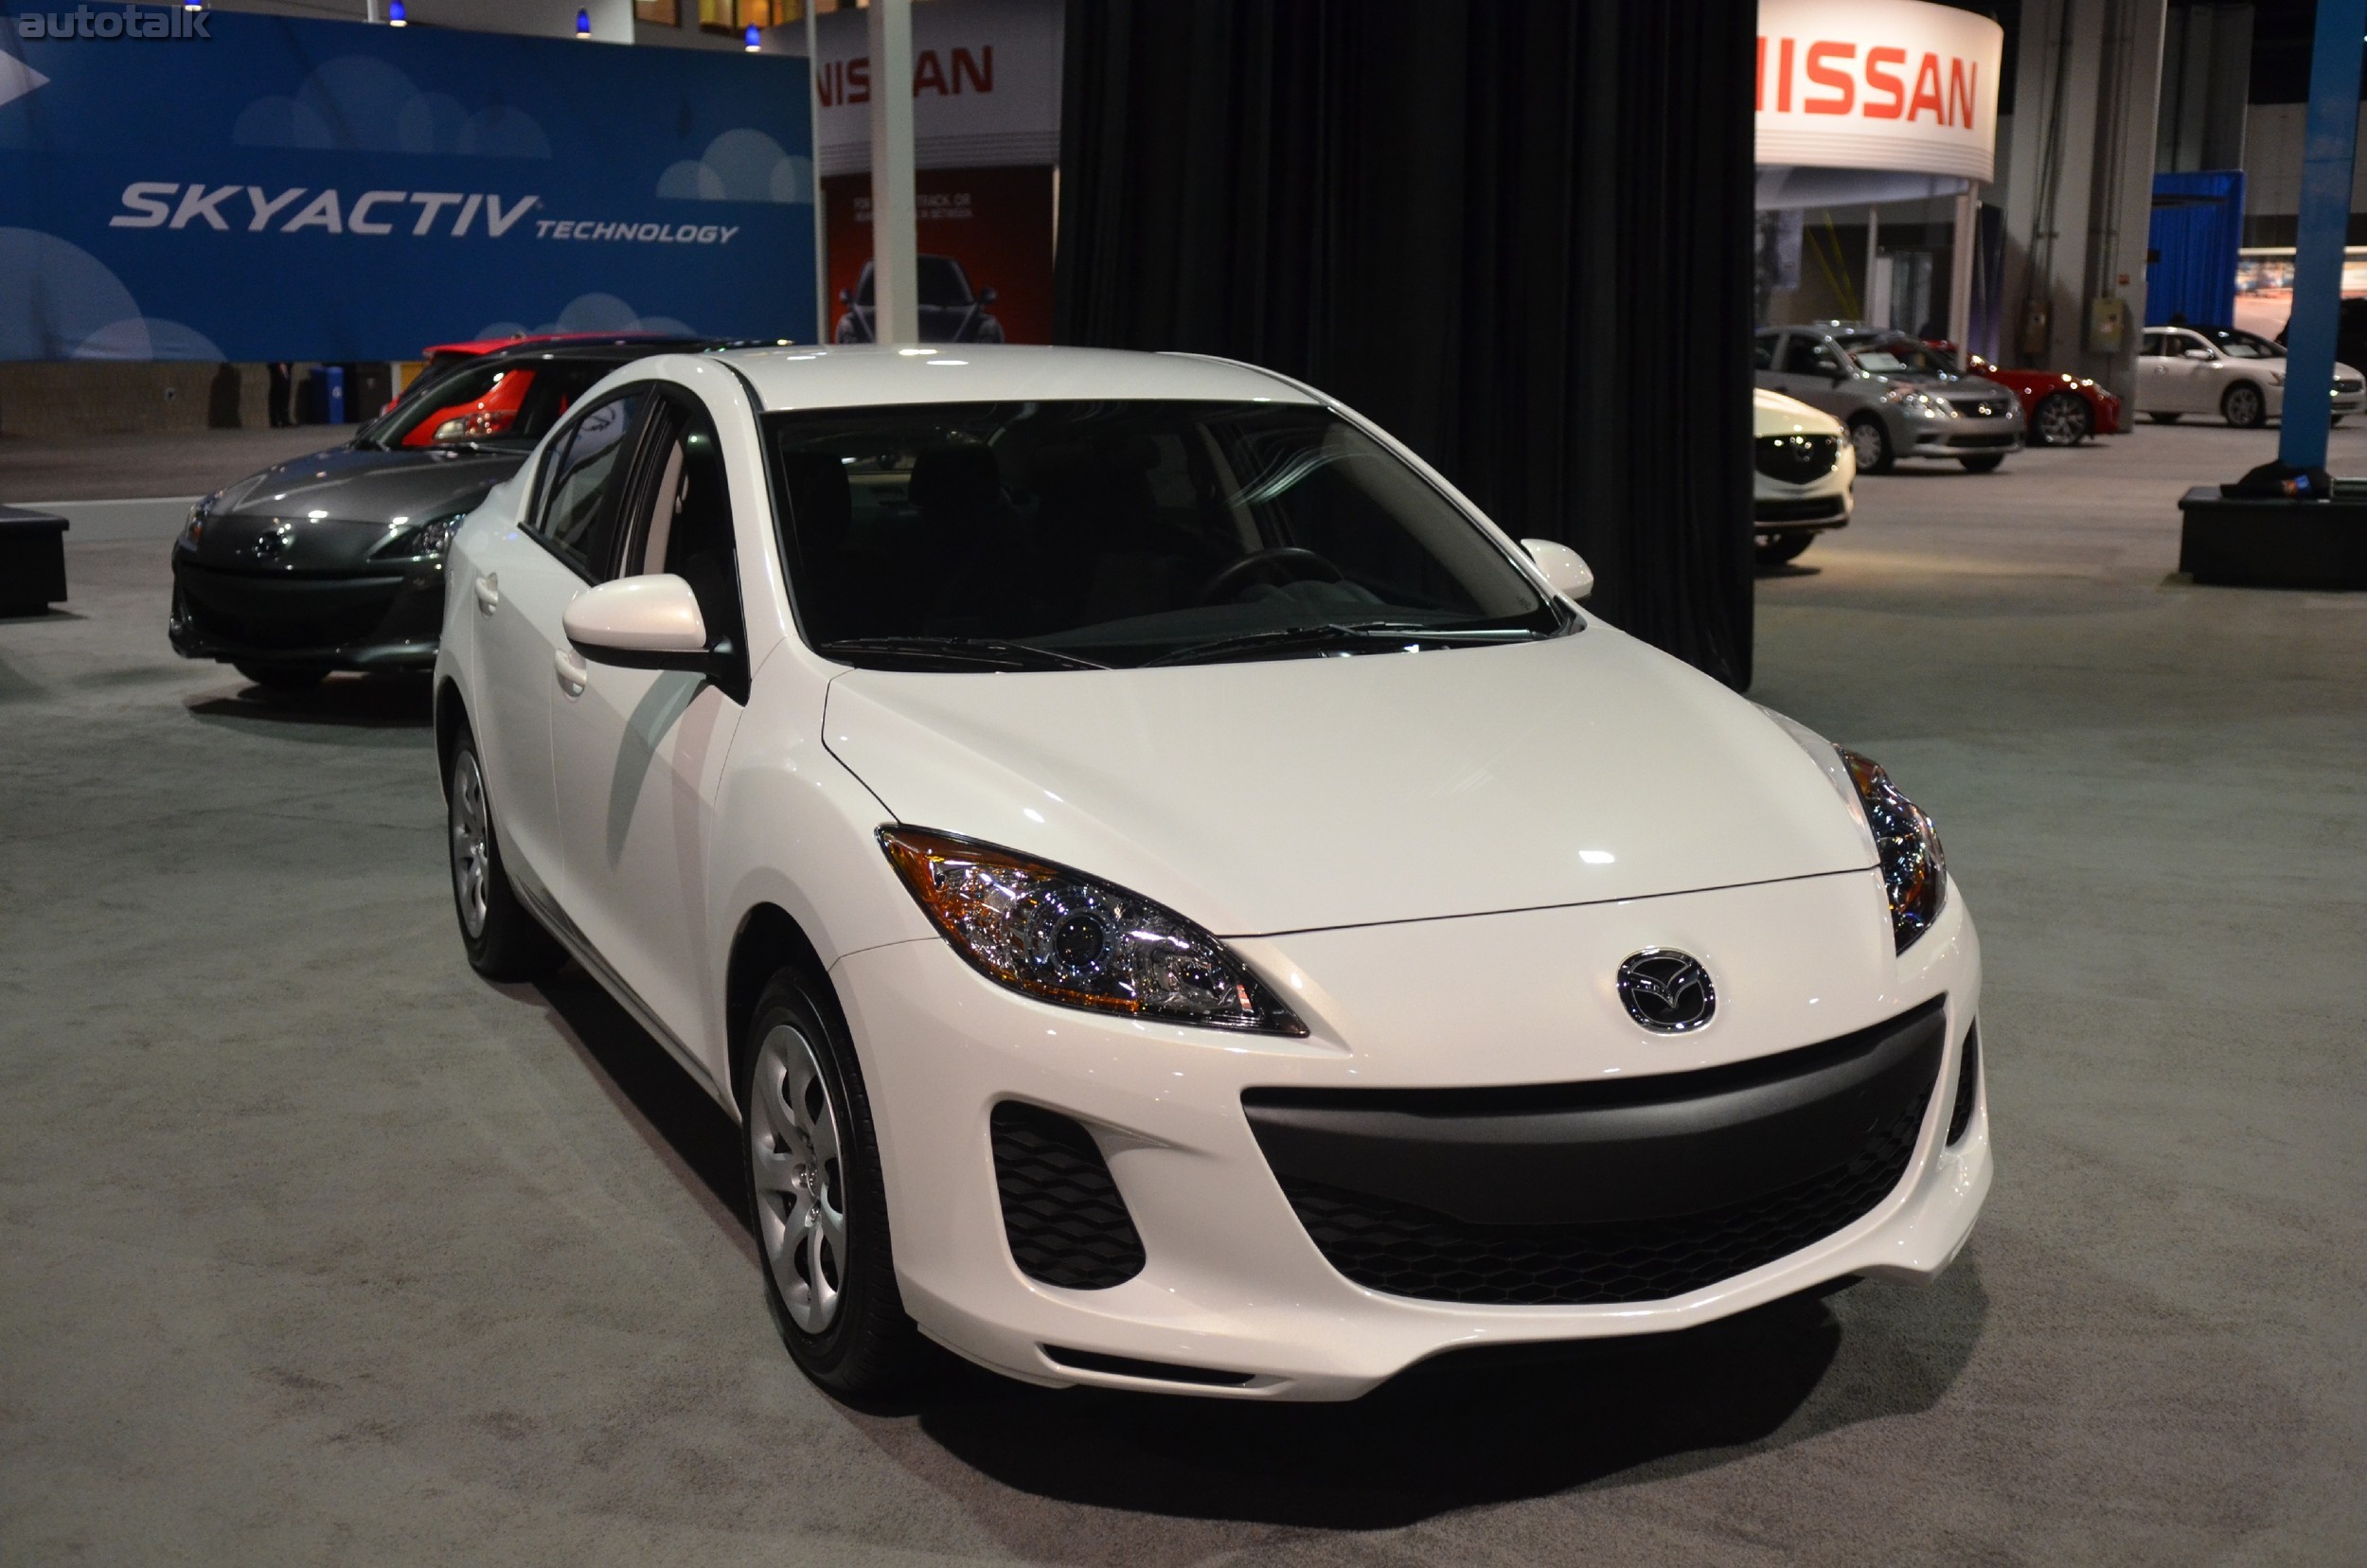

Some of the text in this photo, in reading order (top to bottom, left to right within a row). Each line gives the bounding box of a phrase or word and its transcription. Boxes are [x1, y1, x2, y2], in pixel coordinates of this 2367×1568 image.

[817, 45, 994, 108] NISAN
[1755, 36, 1978, 130] ISSAN
[108, 181, 739, 244] SKYACTIV TECHNOLOGY
